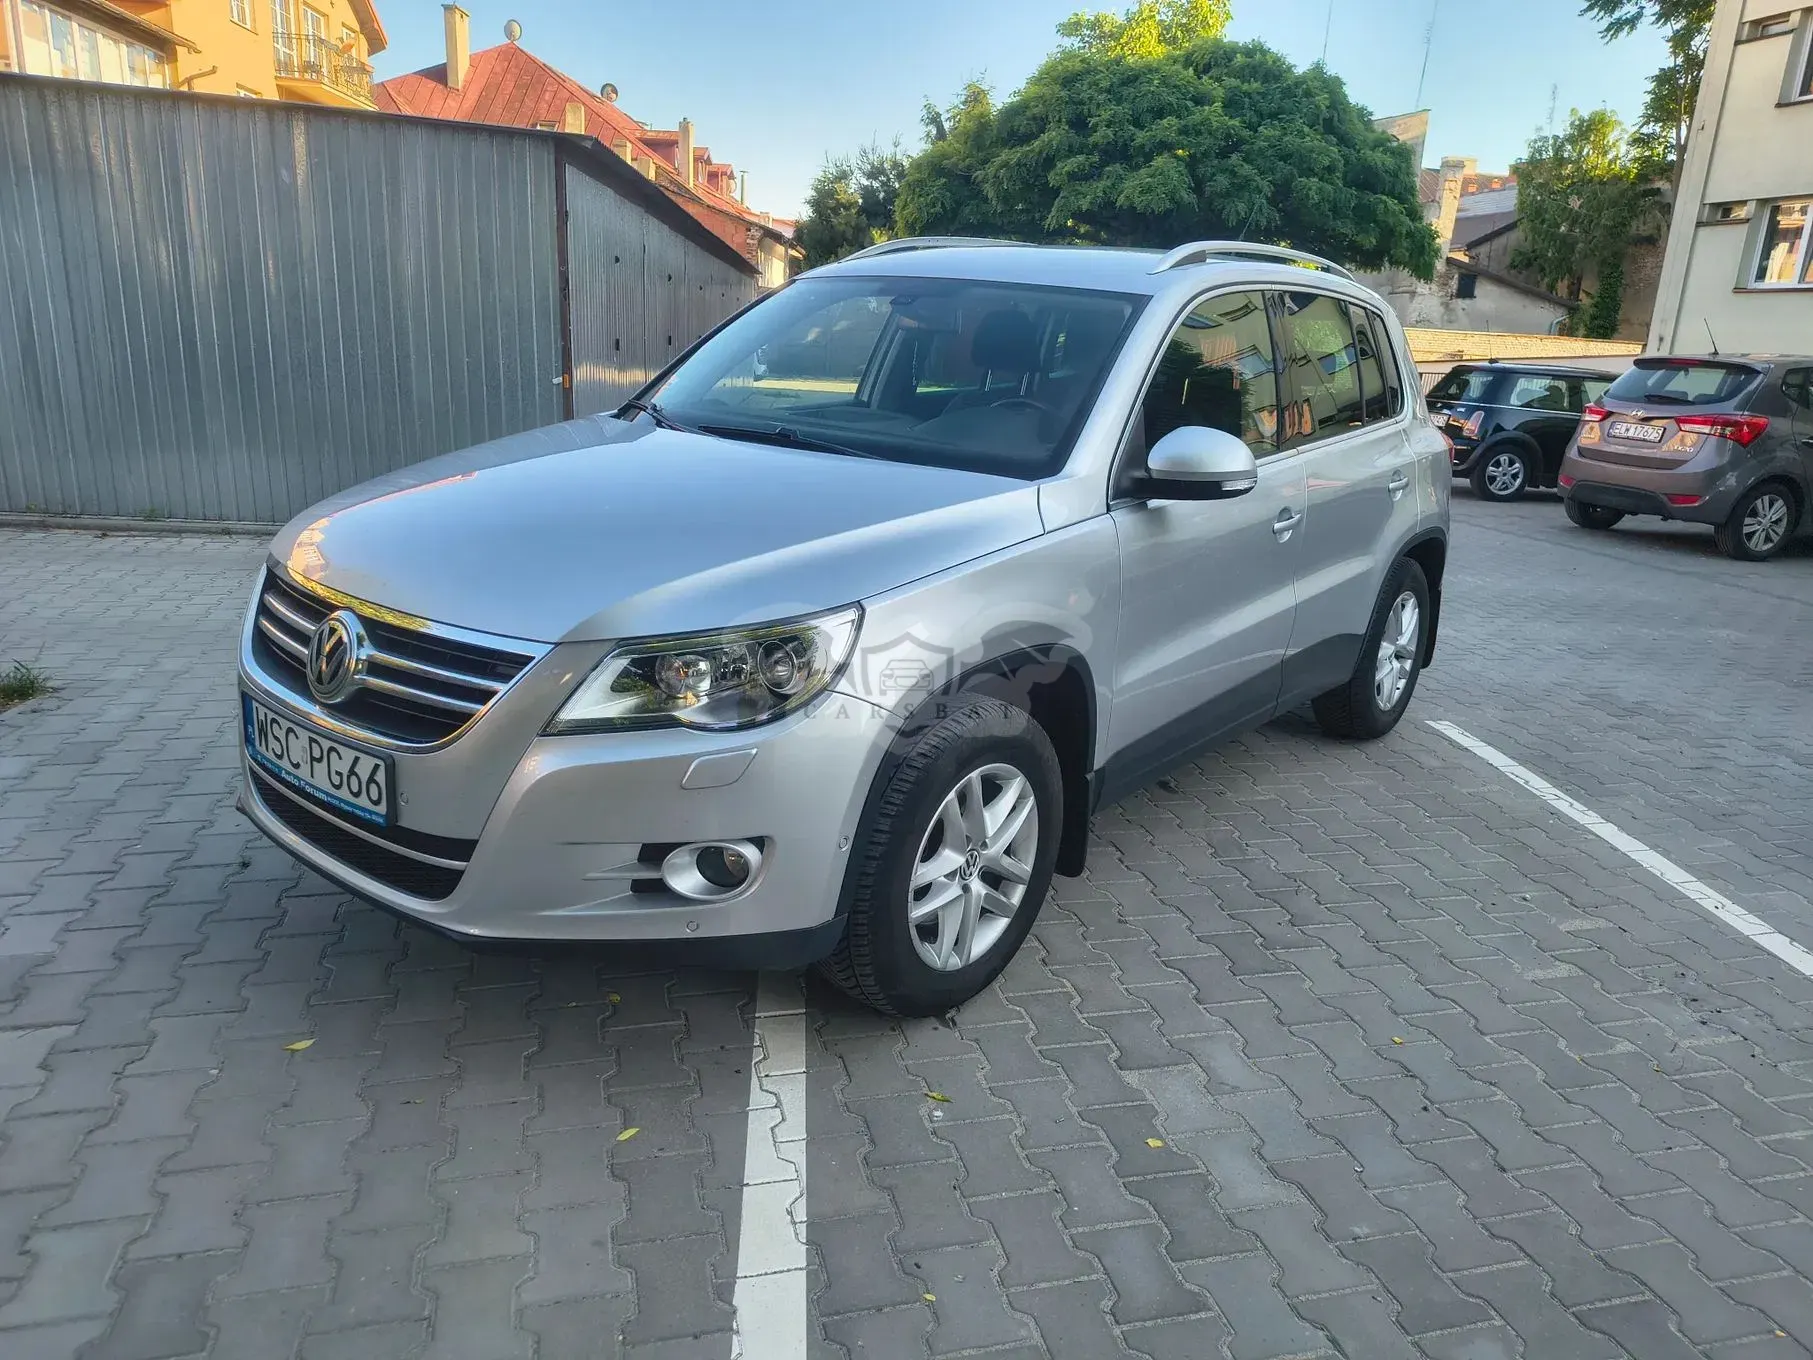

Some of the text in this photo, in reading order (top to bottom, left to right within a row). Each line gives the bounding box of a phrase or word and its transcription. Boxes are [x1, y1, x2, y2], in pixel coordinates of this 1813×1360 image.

[255, 704, 382, 807] WSC PG66
[281, 769, 327, 801] Auto Forum
